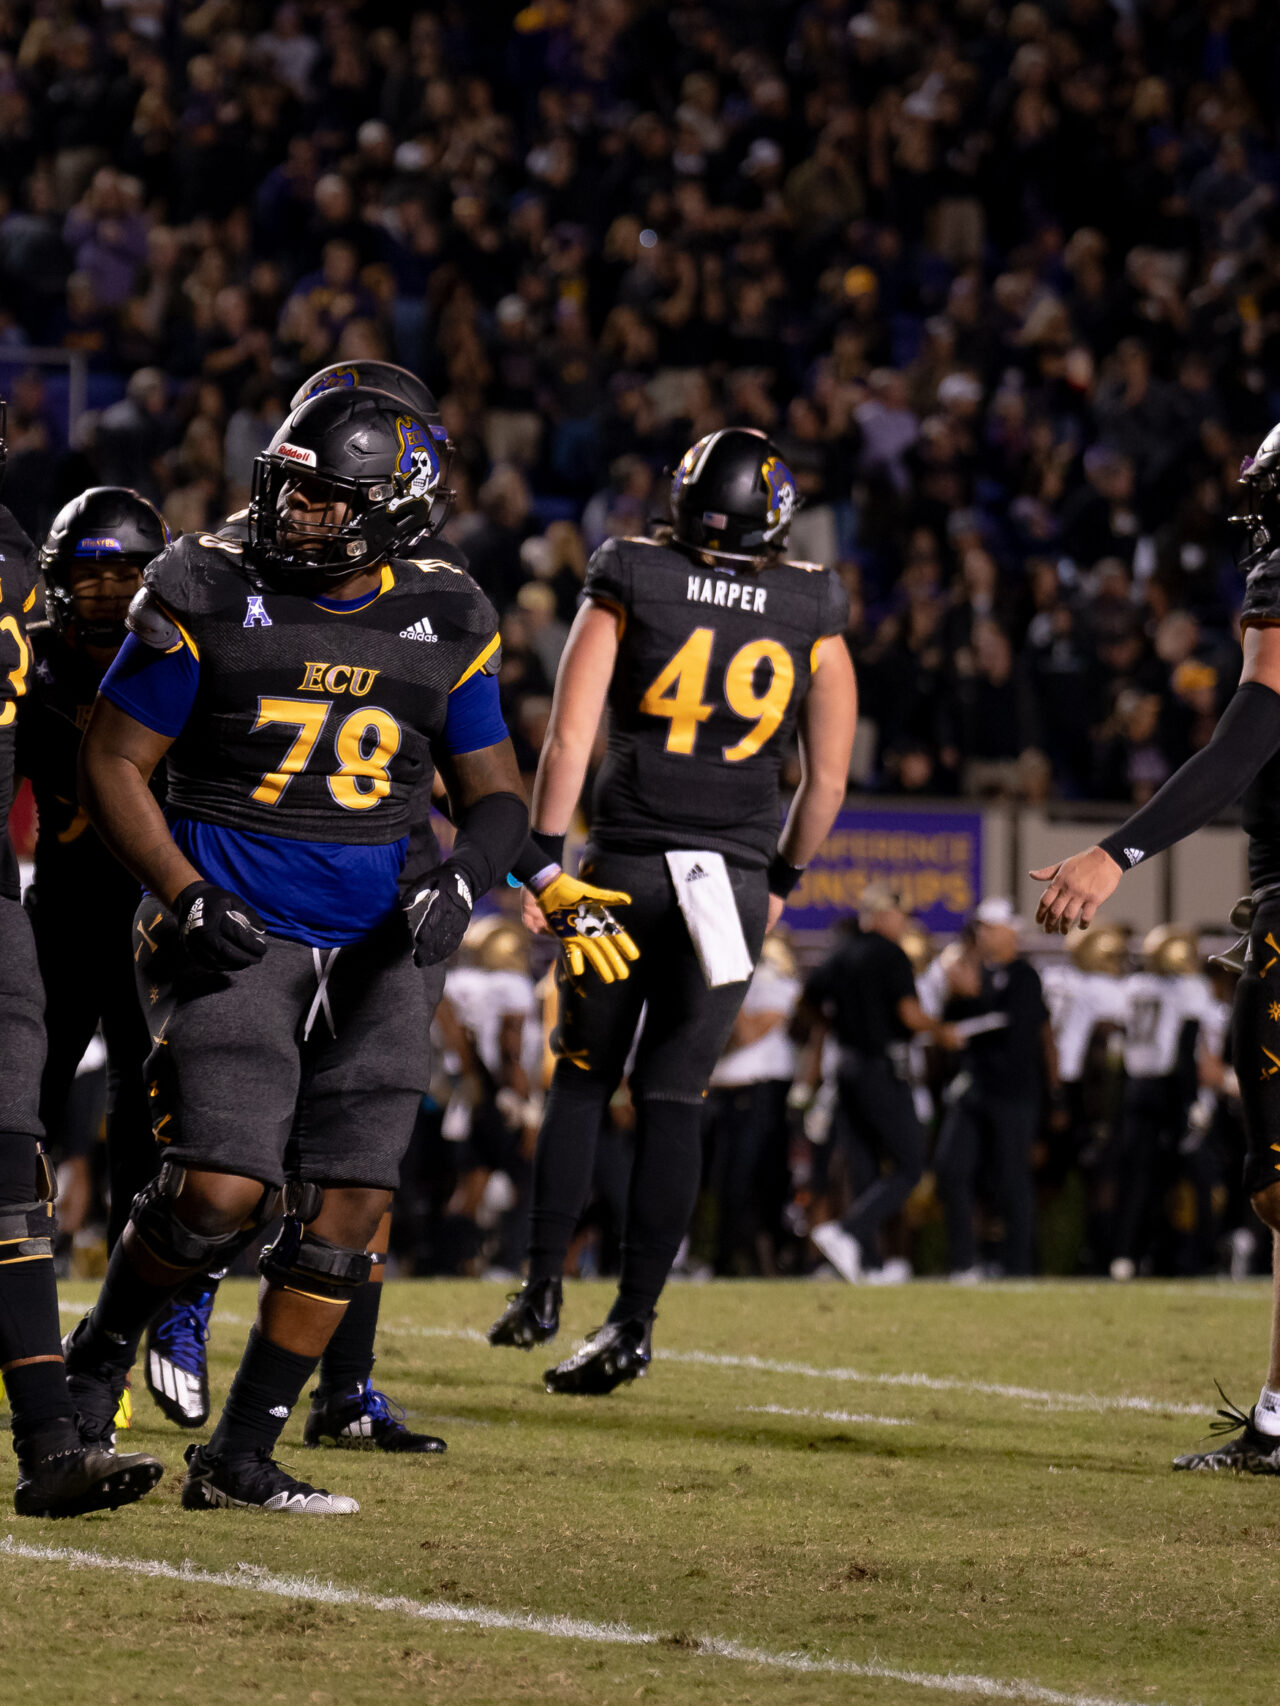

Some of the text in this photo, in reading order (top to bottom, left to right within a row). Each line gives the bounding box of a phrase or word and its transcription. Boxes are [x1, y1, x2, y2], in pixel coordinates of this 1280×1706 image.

[277, 445, 310, 462] Riddell
[686, 575, 767, 614] HARPER
[399, 629, 438, 643] adidas
[297, 661, 381, 696] ECU
[638, 626, 795, 763] 49
[248, 695, 402, 812] 78
